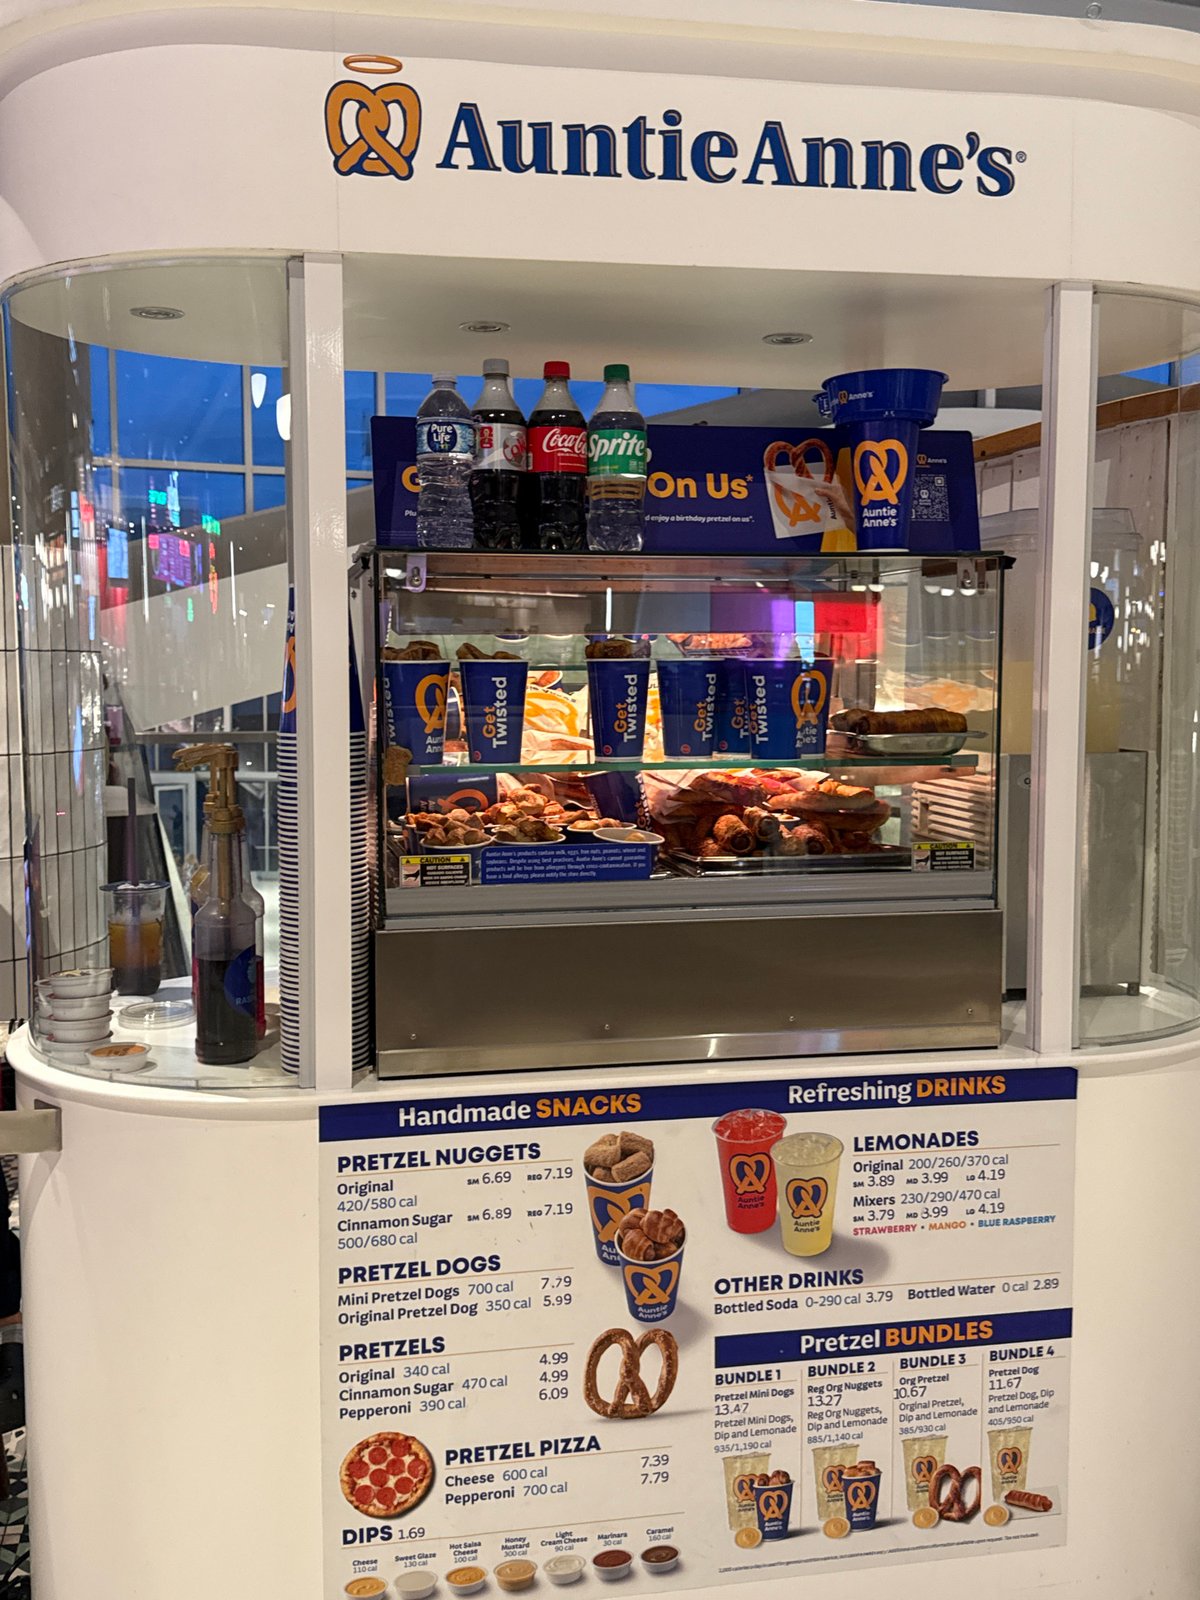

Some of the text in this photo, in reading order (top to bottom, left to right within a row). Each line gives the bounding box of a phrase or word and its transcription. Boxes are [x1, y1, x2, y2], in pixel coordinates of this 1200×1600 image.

[436, 102, 738, 182] Auntie
[431, 424, 453, 433] Pure
[433, 434, 450, 443] Life
[589, 432, 645, 462] Sprite
[647, 471, 697, 498] On
[862, 506, 897, 517] Auntie
[862, 518, 899, 528] Anne's
[492, 677, 507, 749] Twisted
[624, 674, 638, 742] Twisted
[694, 701, 707, 732] Get
[702, 674, 716, 741] Twisted
[753, 675, 768, 744] Twisted
[483, 707, 495, 738] Get
[614, 702, 628, 733] Get
[788, 1075, 1006, 1104] Refreshing DRINKS
[398, 1093, 642, 1128] Handmade SNACKS
[853, 1130, 979, 1152] LEMONADES
[337, 1142, 541, 1173] PRETZEL NUGGETS
[853, 1153, 1009, 1175] Original 200/260/370 cal
[481, 1167, 573, 1185] 6.69 7.19
[867, 1168, 1006, 1187] 3.89 3.99 4.19
[337, 1179, 394, 1197] Original
[336, 1195, 417, 1213] 420/580 cal
[853, 1188, 1001, 1208] Mixers 230/290/470 cal
[337, 1210, 453, 1233] Cinnamon Sugar
[482, 1203, 573, 1221] 6.89 7.19
[867, 1202, 1005, 1222] 3.79 3.99 4.19
[853, 1215, 1056, 1236] STRAWBERRY MANGO BLUE RASPBERRY
[337, 1232, 418, 1250] 500/680 cal
[338, 1254, 501, 1285] PRETZEL DOGS
[337, 1275, 573, 1307] Mini Pretzel Dogs 700 cal 7.79
[714, 1268, 864, 1295] OTHER DRINKS
[714, 1278, 1060, 1315] Bottled Soda 0-290 cal 3.79 Bottled Water 0 cal 2.89
[338, 1293, 573, 1326] Original Pretzel Dog 350 cal 5.99
[800, 1320, 993, 1354] Pretzel BUNDLES
[338, 1336, 446, 1361] PRETZELS
[989, 1346, 1055, 1362] BUNDLE 4
[338, 1352, 569, 1385] Original 340 cal 4.99
[807, 1361, 875, 1377] BUNDLE 2
[900, 1354, 966, 1370] BUNDLE 3
[715, 1369, 781, 1387] BUNDLE 1
[899, 1373, 950, 1387] Org Pretzel
[989, 1365, 1040, 1380] Pretzel Dog
[338, 1370, 569, 1402] Cinnamon Sugar 470 cal 4.99
[807, 1379, 883, 1396] Reg Org Nuggets
[893, 1386, 927, 1400] 10.67
[989, 1377, 1022, 1390] 11.67
[338, 1387, 569, 1421] Pepperoni 390 cal 6.09
[714, 1387, 794, 1403] Pretzel Mini Dogs
[807, 1393, 842, 1407] 13.27
[714, 1402, 749, 1416] 13.47
[899, 1397, 965, 1413] Orginal Pretzel,
[445, 1435, 601, 1466] PRETZEL PIZZA
[445, 1454, 669, 1488] Cheese 600 cal 7.39
[445, 1471, 669, 1506] Pepperoni 700 cal 7.79
[342, 1525, 426, 1545] DIPS 1.69
[504, 1536, 527, 1545] Honey
[555, 1530, 573, 1539] Light
[597, 1531, 628, 1541] Marinara
[646, 1527, 674, 1535] Caramel
[449, 1543, 463, 1551] Hot
[501, 1541, 530, 1550] Mustard
[540, 1536, 588, 1547] Cream Cheese
[394, 1552, 437, 1563] Sweet Glaze
[452, 1548, 479, 1557] Cheese
[352, 1558, 378, 1567] Cheese
